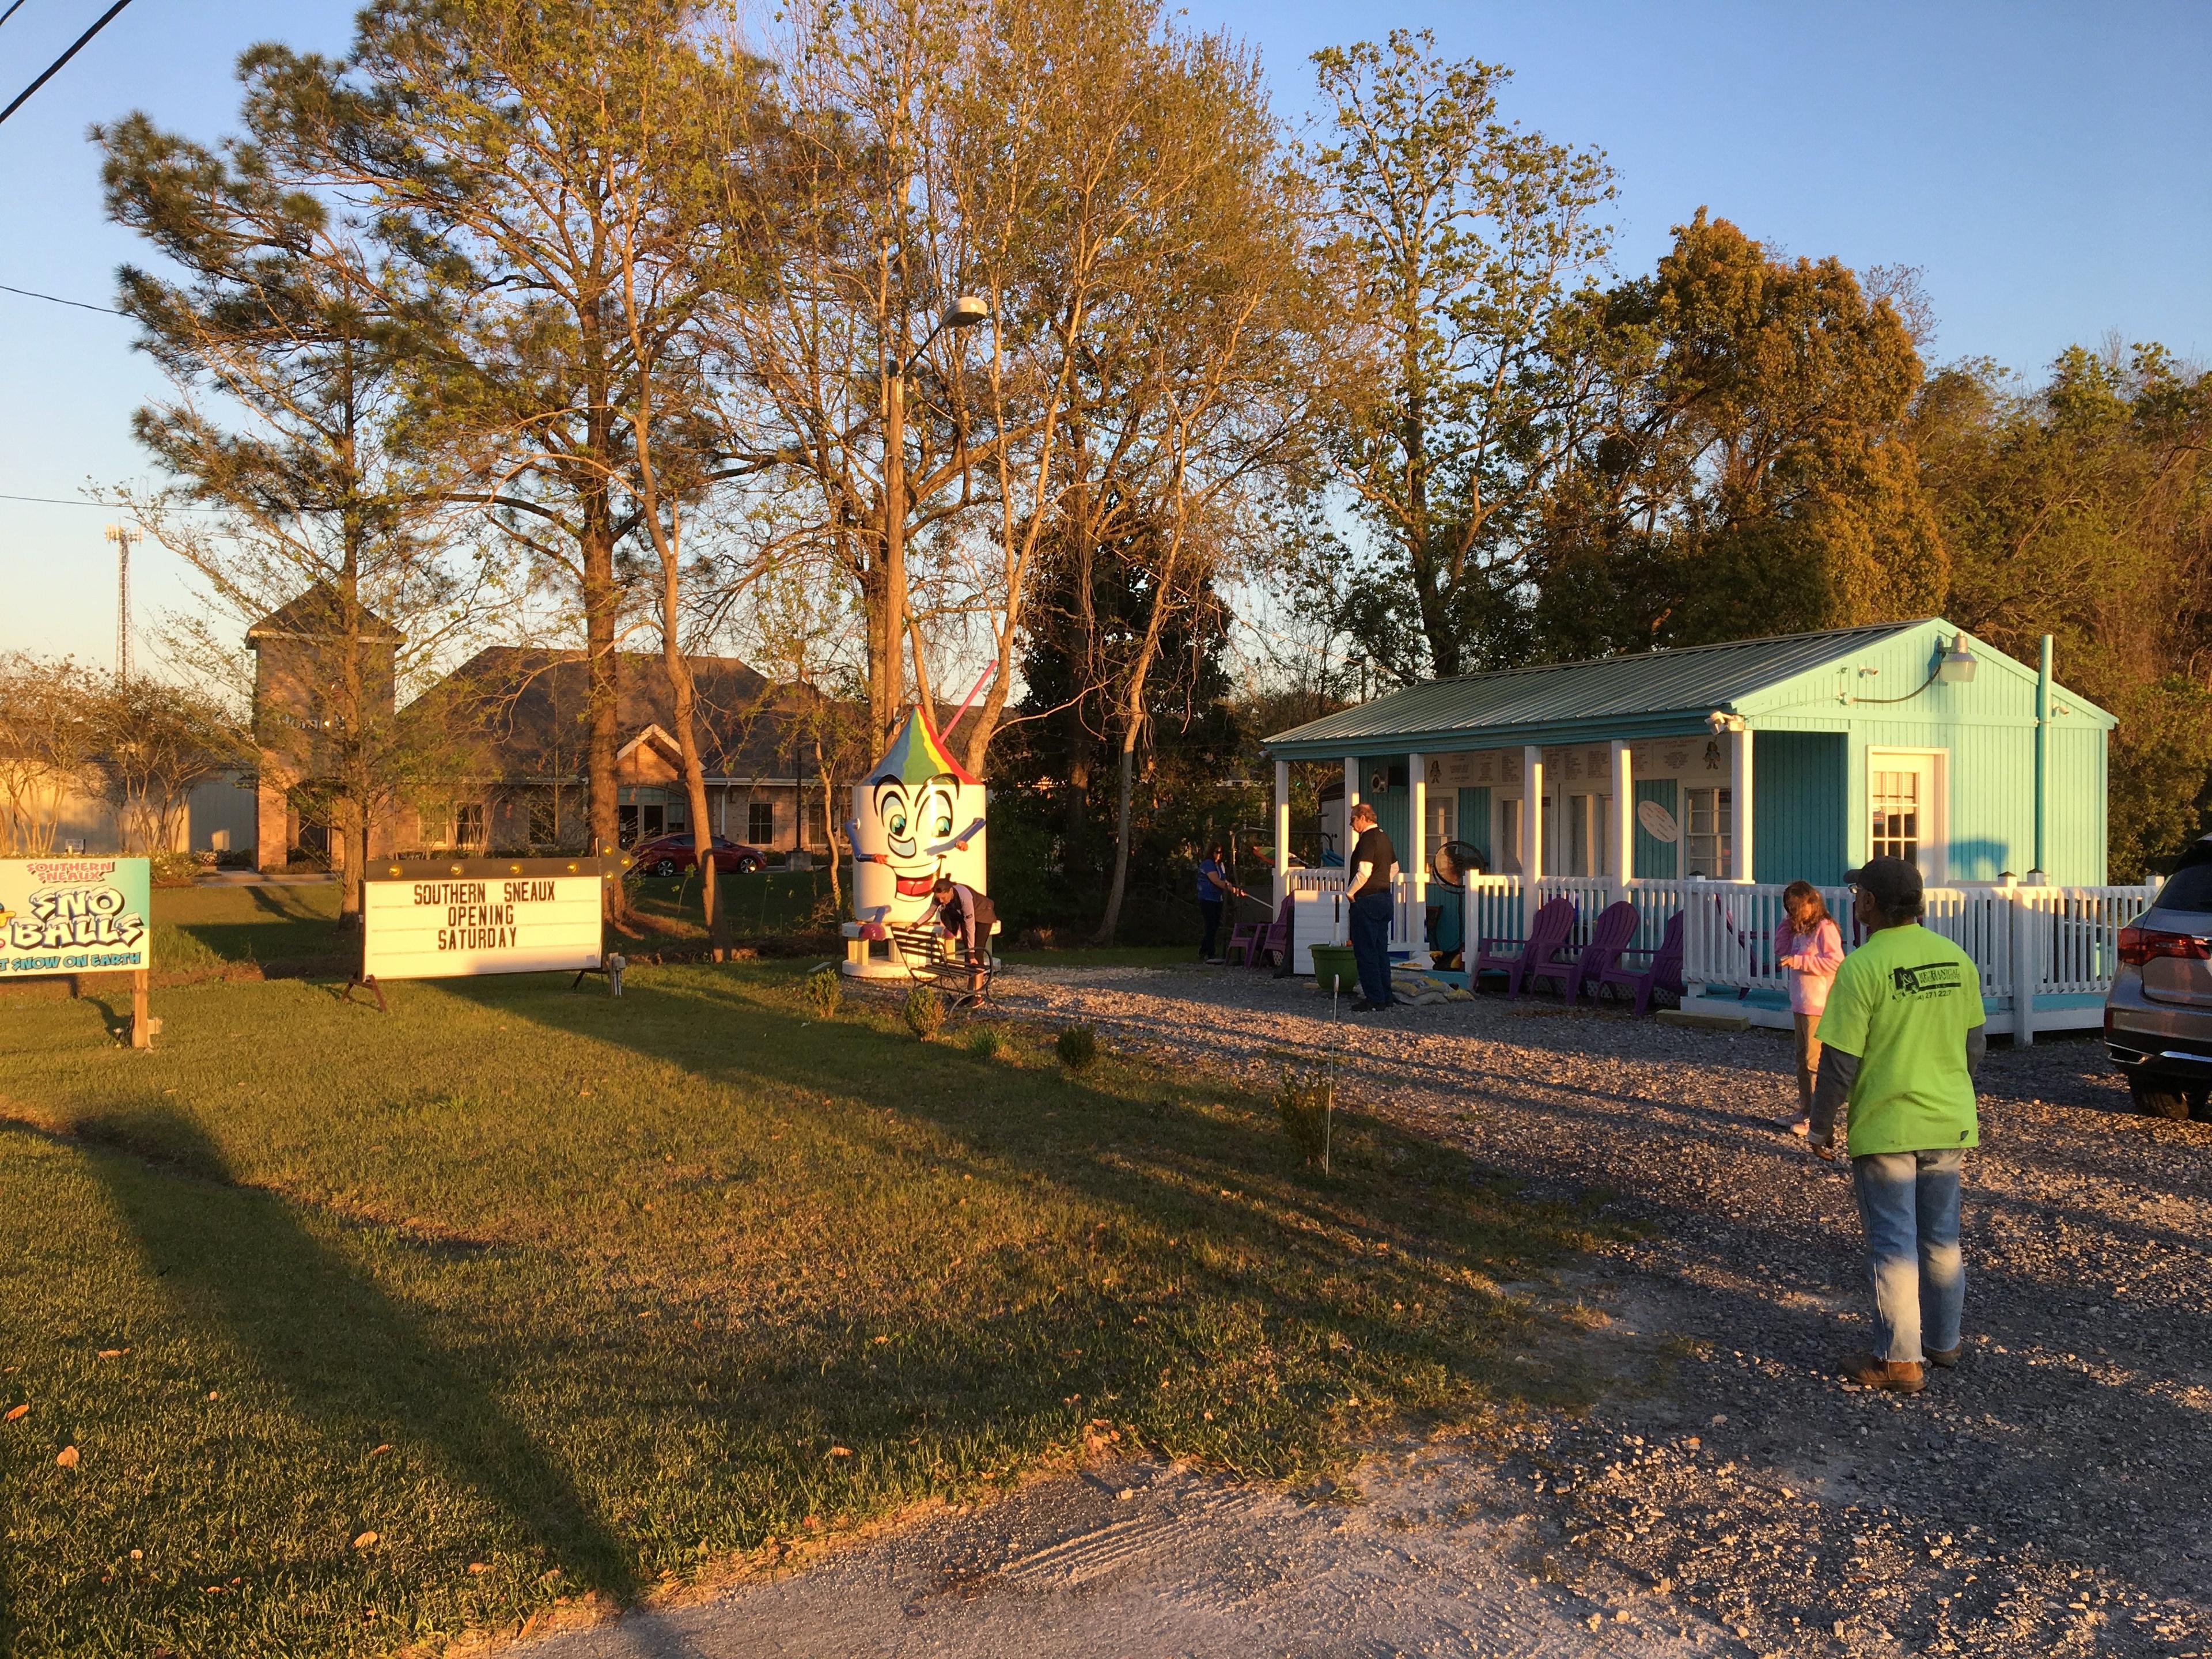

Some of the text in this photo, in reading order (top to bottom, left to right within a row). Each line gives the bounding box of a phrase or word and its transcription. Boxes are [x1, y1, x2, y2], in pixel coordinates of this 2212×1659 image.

[26, 862, 115, 874] SOUTHERN
[37, 872, 105, 883] SNEAUX
[29, 886, 124, 921] SNO
[414, 881, 555, 905] SOUTHERN SNEAUX
[448, 904, 514, 927] OPENING
[9, 912, 144, 950] BALLS
[438, 927, 517, 950] SATURDAY
[12, 956, 61, 971] SNOW
[62, 954, 88, 969] ON
[90, 952, 141, 966] EARTH
